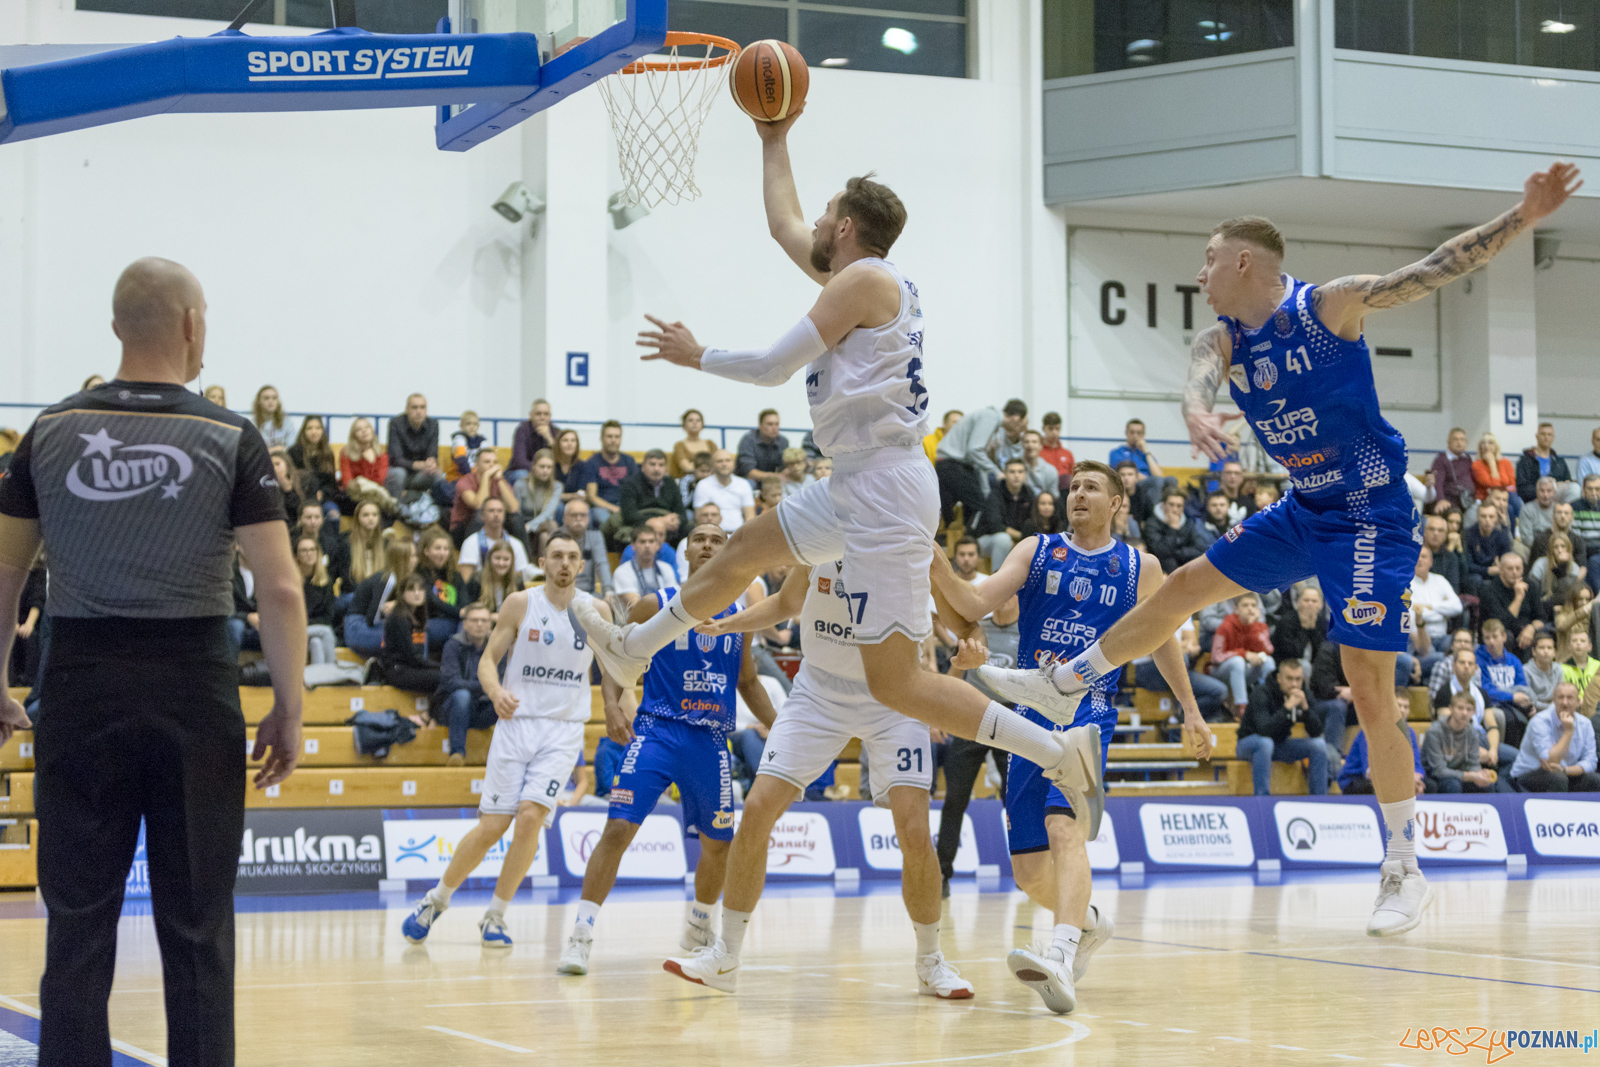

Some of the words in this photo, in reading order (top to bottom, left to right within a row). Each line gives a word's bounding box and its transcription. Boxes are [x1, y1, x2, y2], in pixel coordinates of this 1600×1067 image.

[248, 51, 350, 73] SPORT
[353, 45, 474, 77] SYSTEM
[762, 57, 775, 103] molten
[1100, 281, 1200, 329] CIT
[570, 356, 585, 381] C
[1286, 345, 1312, 374] 41
[1508, 398, 1520, 420] B
[1255, 407, 1317, 431] GRUPA
[92, 455, 169, 489] LOTTO
[1353, 522, 1378, 595] PRUDNIK
[1100, 584, 1117, 606] 10
[1352, 607, 1377, 618] LOTTO
[814, 620, 855, 639] BIOF
[1043, 618, 1097, 638] GRUPA
[724, 635, 732, 654] 0
[1040, 629, 1095, 648] AZOTY
[523, 665, 583, 682] BIOFARM
[683, 670, 727, 684] GRUPA
[683, 681, 727, 694] AZOTY
[681, 698, 720, 712] Cichon
[897, 748, 922, 772] 31
[546, 779, 560, 797] 8
[718, 750, 731, 808] PRUDNIK
[1160, 813, 1229, 830] HELMEX
[1444, 823, 1489, 838] Danuty
[1536, 823, 1600, 838] BIOFAR
[1164, 833, 1232, 846] EXHIBITIONS
[305, 859, 382, 875] SKOCZYŃSKI
